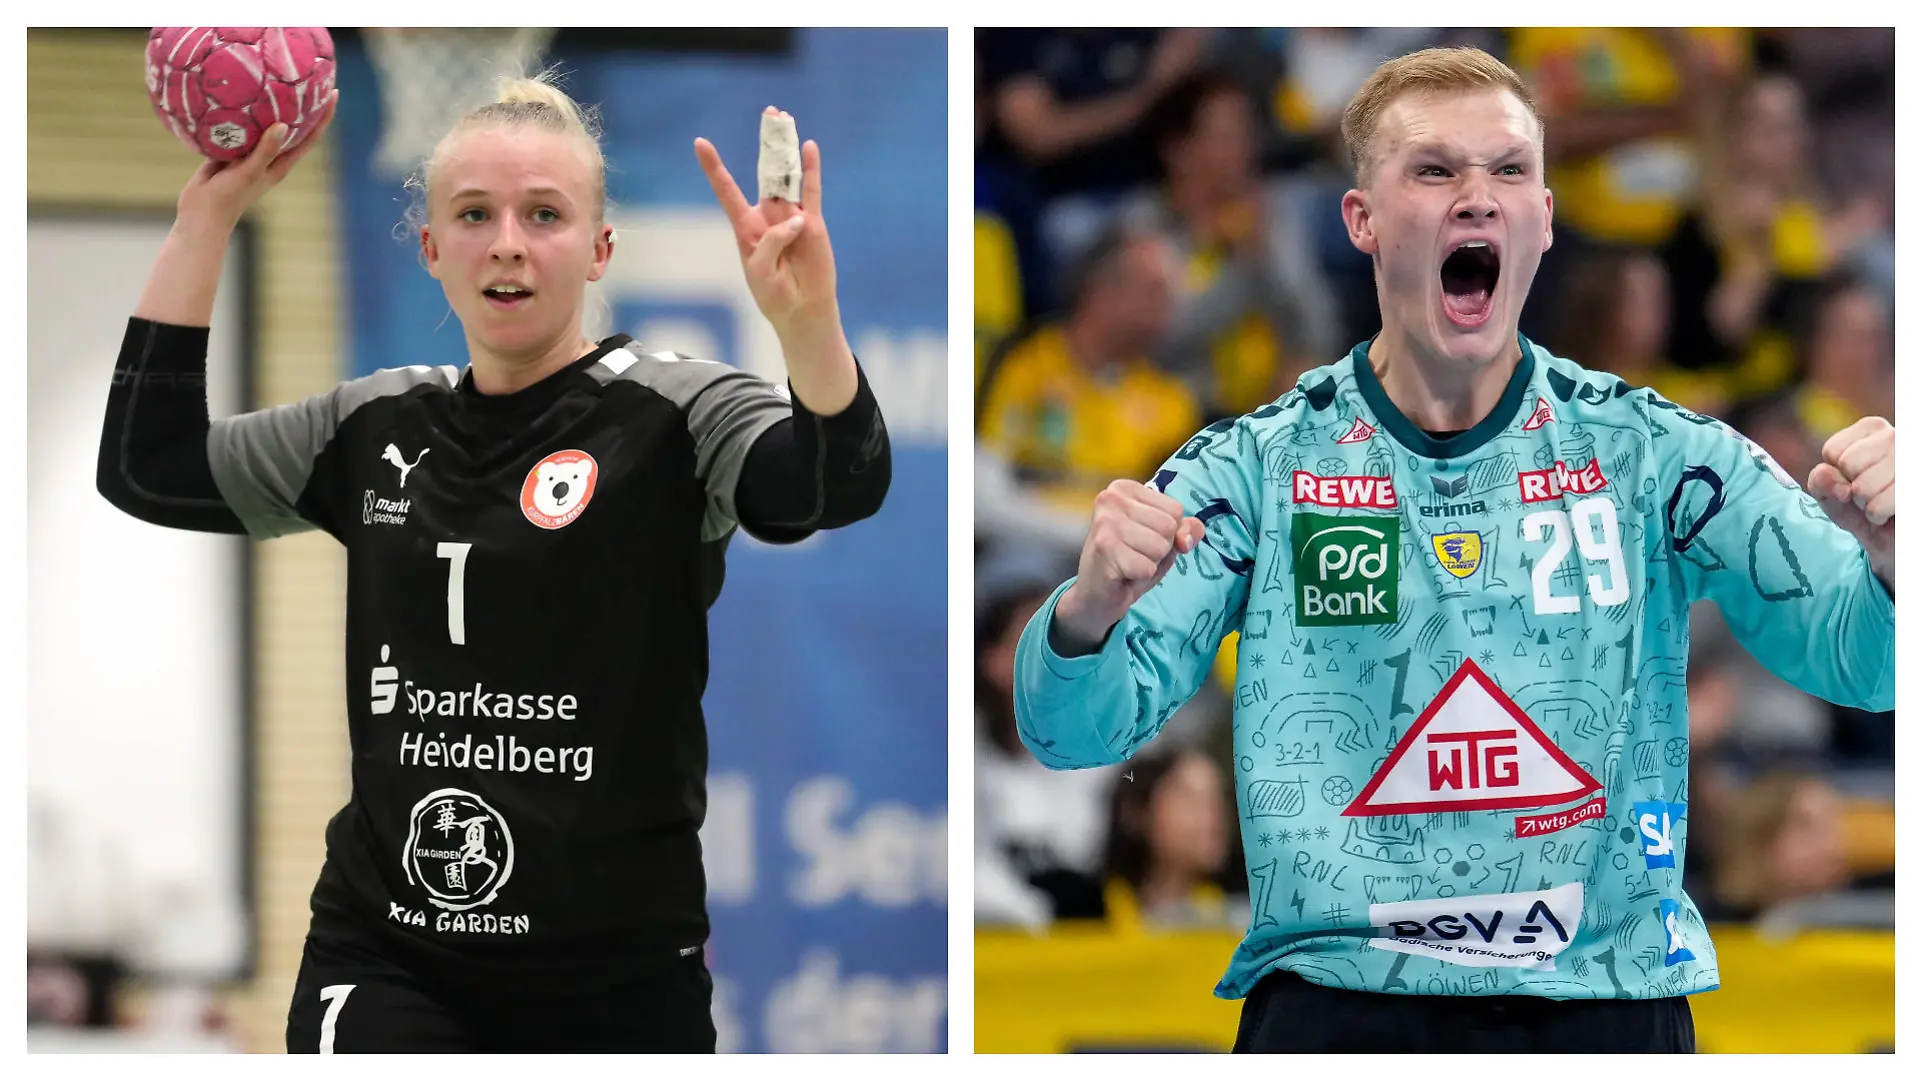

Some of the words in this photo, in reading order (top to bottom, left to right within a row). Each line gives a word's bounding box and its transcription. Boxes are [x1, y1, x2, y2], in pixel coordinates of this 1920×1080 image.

[375, 498, 411, 513] markt
[1297, 474, 1395, 505] REWE
[373, 512, 406, 525] apotheke
[1420, 500, 1486, 518] erima
[1319, 543, 1388, 581] psd
[1523, 497, 1630, 615] 29
[436, 541, 474, 645] 7
[1304, 584, 1389, 616] Bank
[405, 680, 578, 722] Sparkasse
[400, 732, 594, 781] Heidelberg
[1427, 729, 1519, 791] WTG
[1538, 803, 1602, 829] wtg.com
[388, 902, 426, 927] XIA
[436, 911, 529, 935] GARDEN
[1458, 946, 1556, 961] Versicherunge
